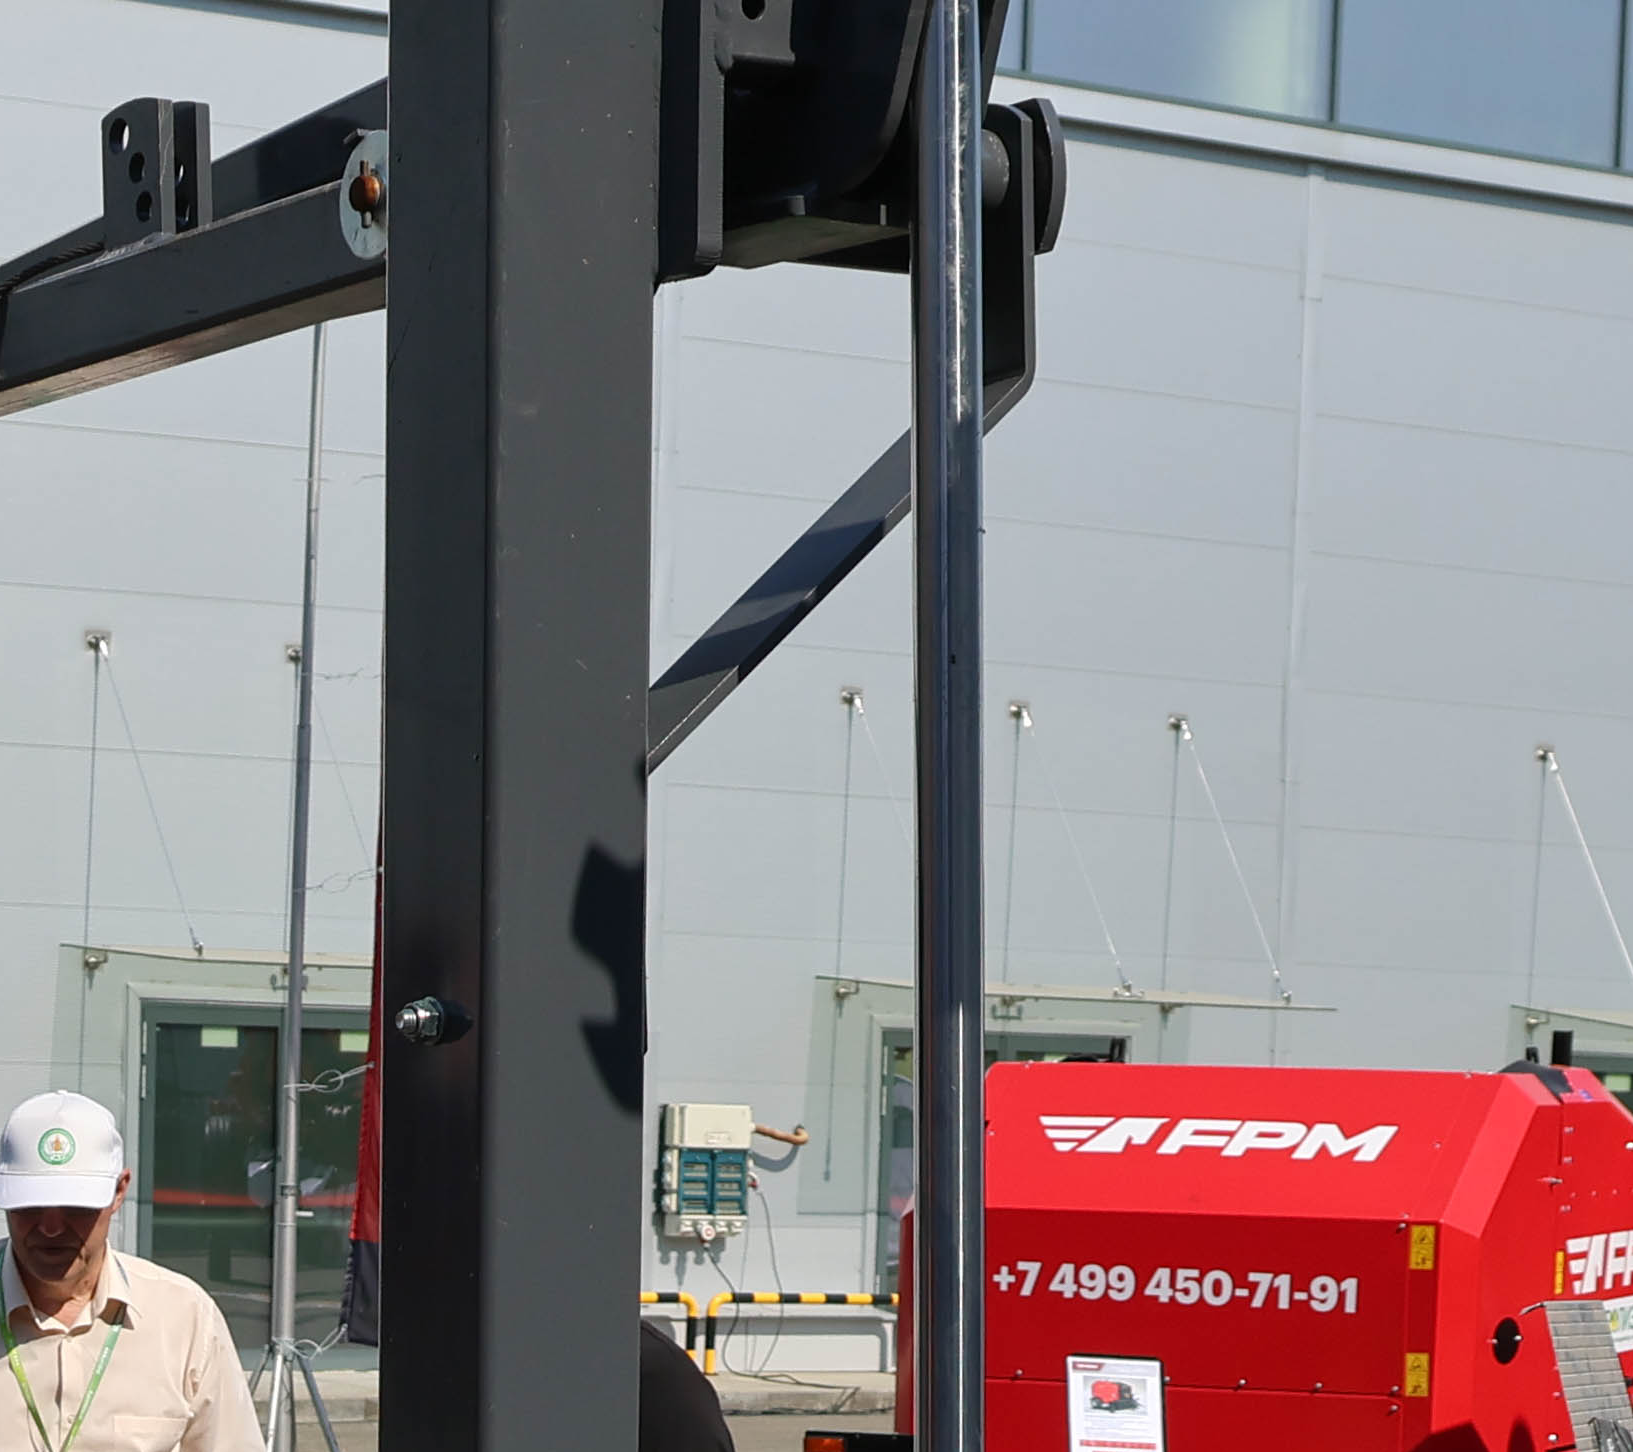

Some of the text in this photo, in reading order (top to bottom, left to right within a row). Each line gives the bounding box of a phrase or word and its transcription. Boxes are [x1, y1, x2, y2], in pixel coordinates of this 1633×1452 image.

[1156, 1119, 1399, 1162] FPM
[993, 1261, 1360, 1314] +7 499 450-71-91
